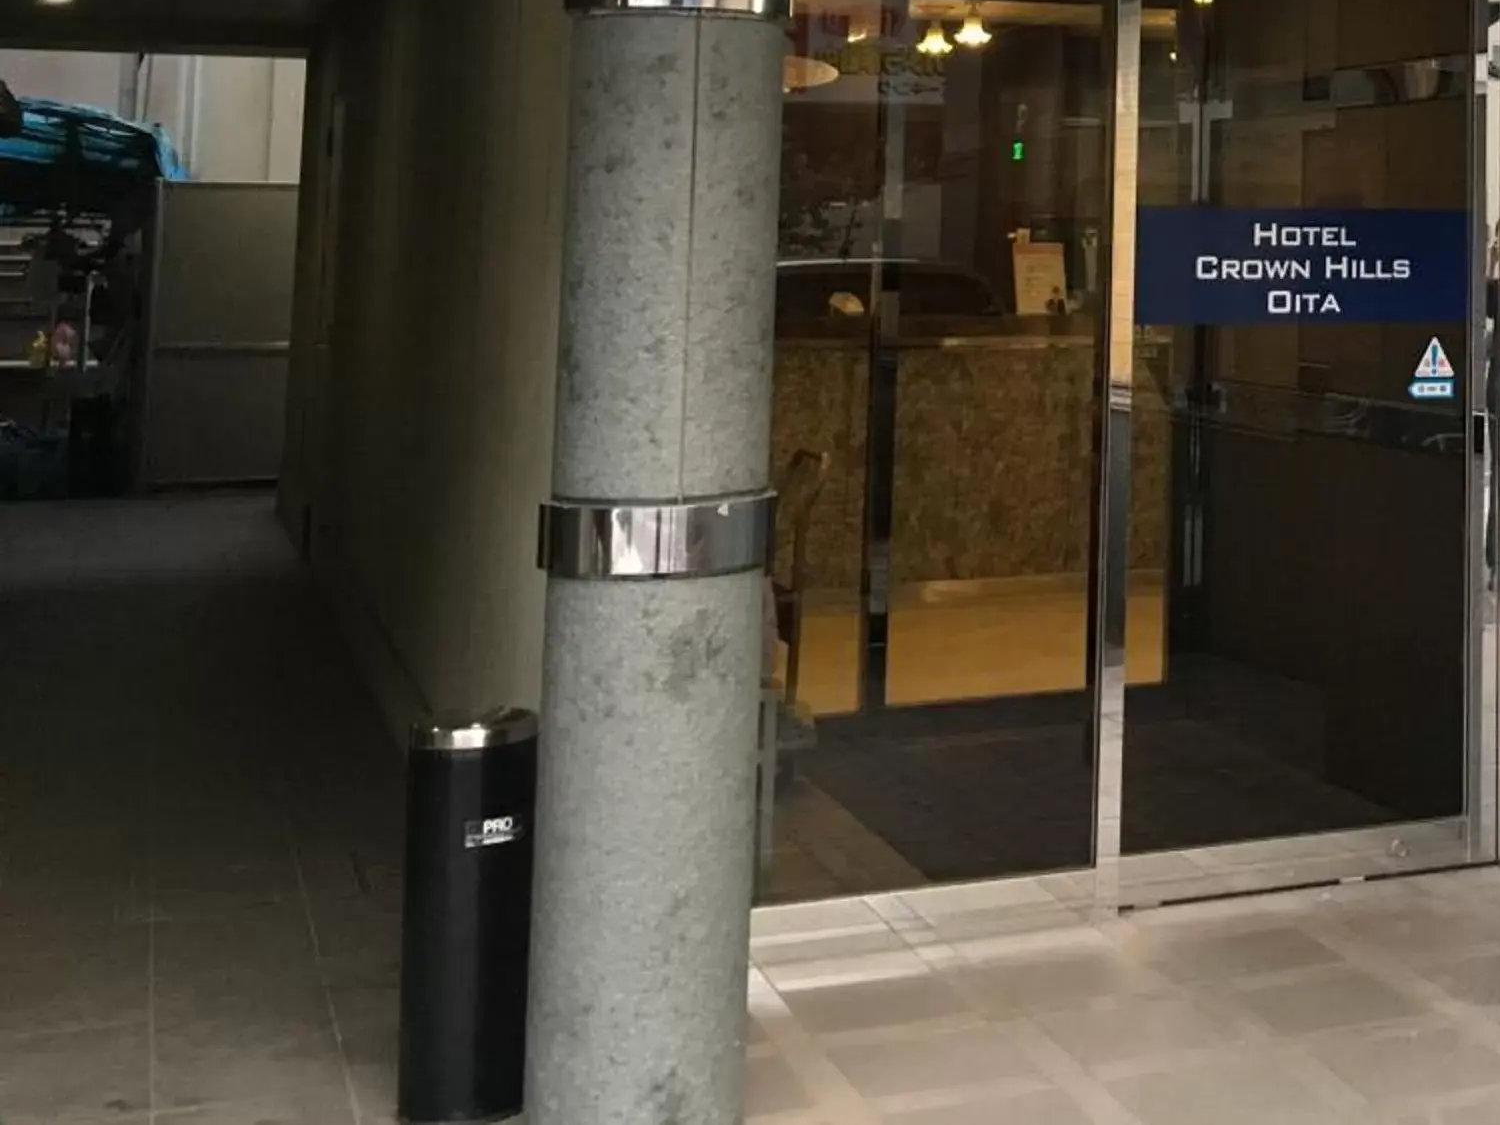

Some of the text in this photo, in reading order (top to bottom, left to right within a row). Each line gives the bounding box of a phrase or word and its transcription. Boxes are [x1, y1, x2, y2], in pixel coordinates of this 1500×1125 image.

[1253, 222, 1357, 247] HOTEL
[1195, 255, 1411, 280] CROWN HILLS
[1266, 290, 1341, 315] OITA
